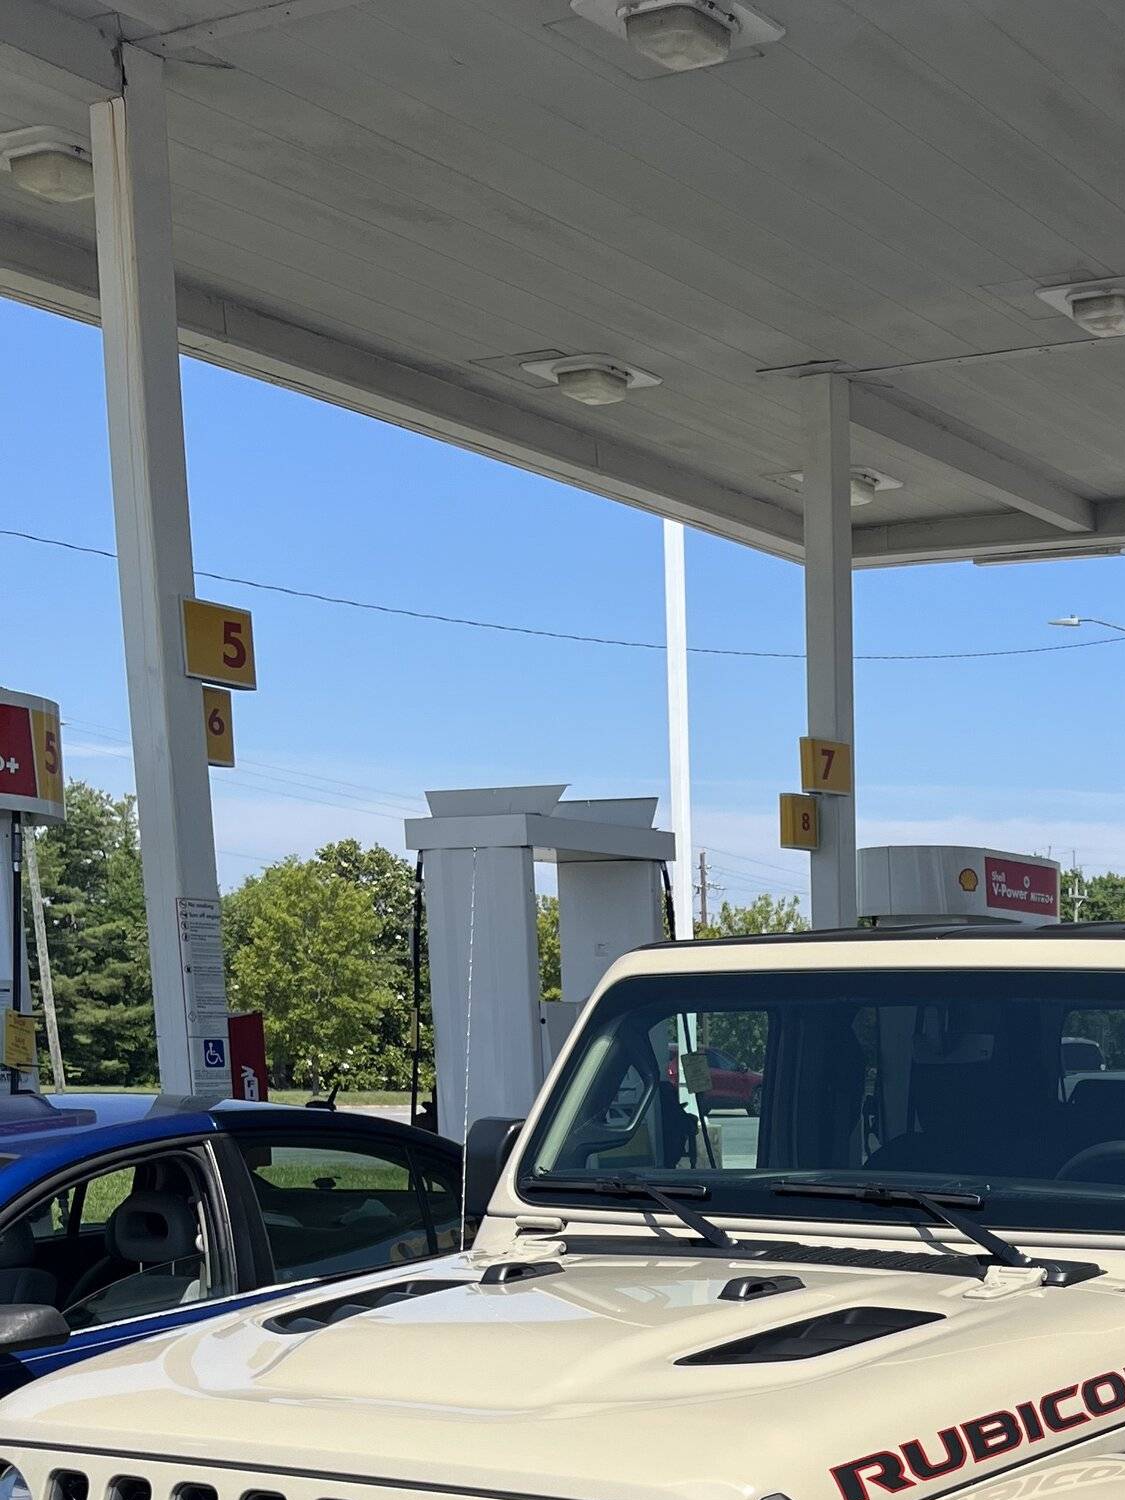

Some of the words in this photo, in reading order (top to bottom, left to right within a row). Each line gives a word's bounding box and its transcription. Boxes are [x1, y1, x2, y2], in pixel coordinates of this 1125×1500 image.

[222, 621, 246, 668] 5
[208, 708, 225, 736] 6
[45, 731, 58, 774] 5
[821, 749, 835, 780] 7
[802, 812, 811, 832] 8
[991, 871, 1006, 883] Shell
[992, 883, 1028, 900] V-Power
